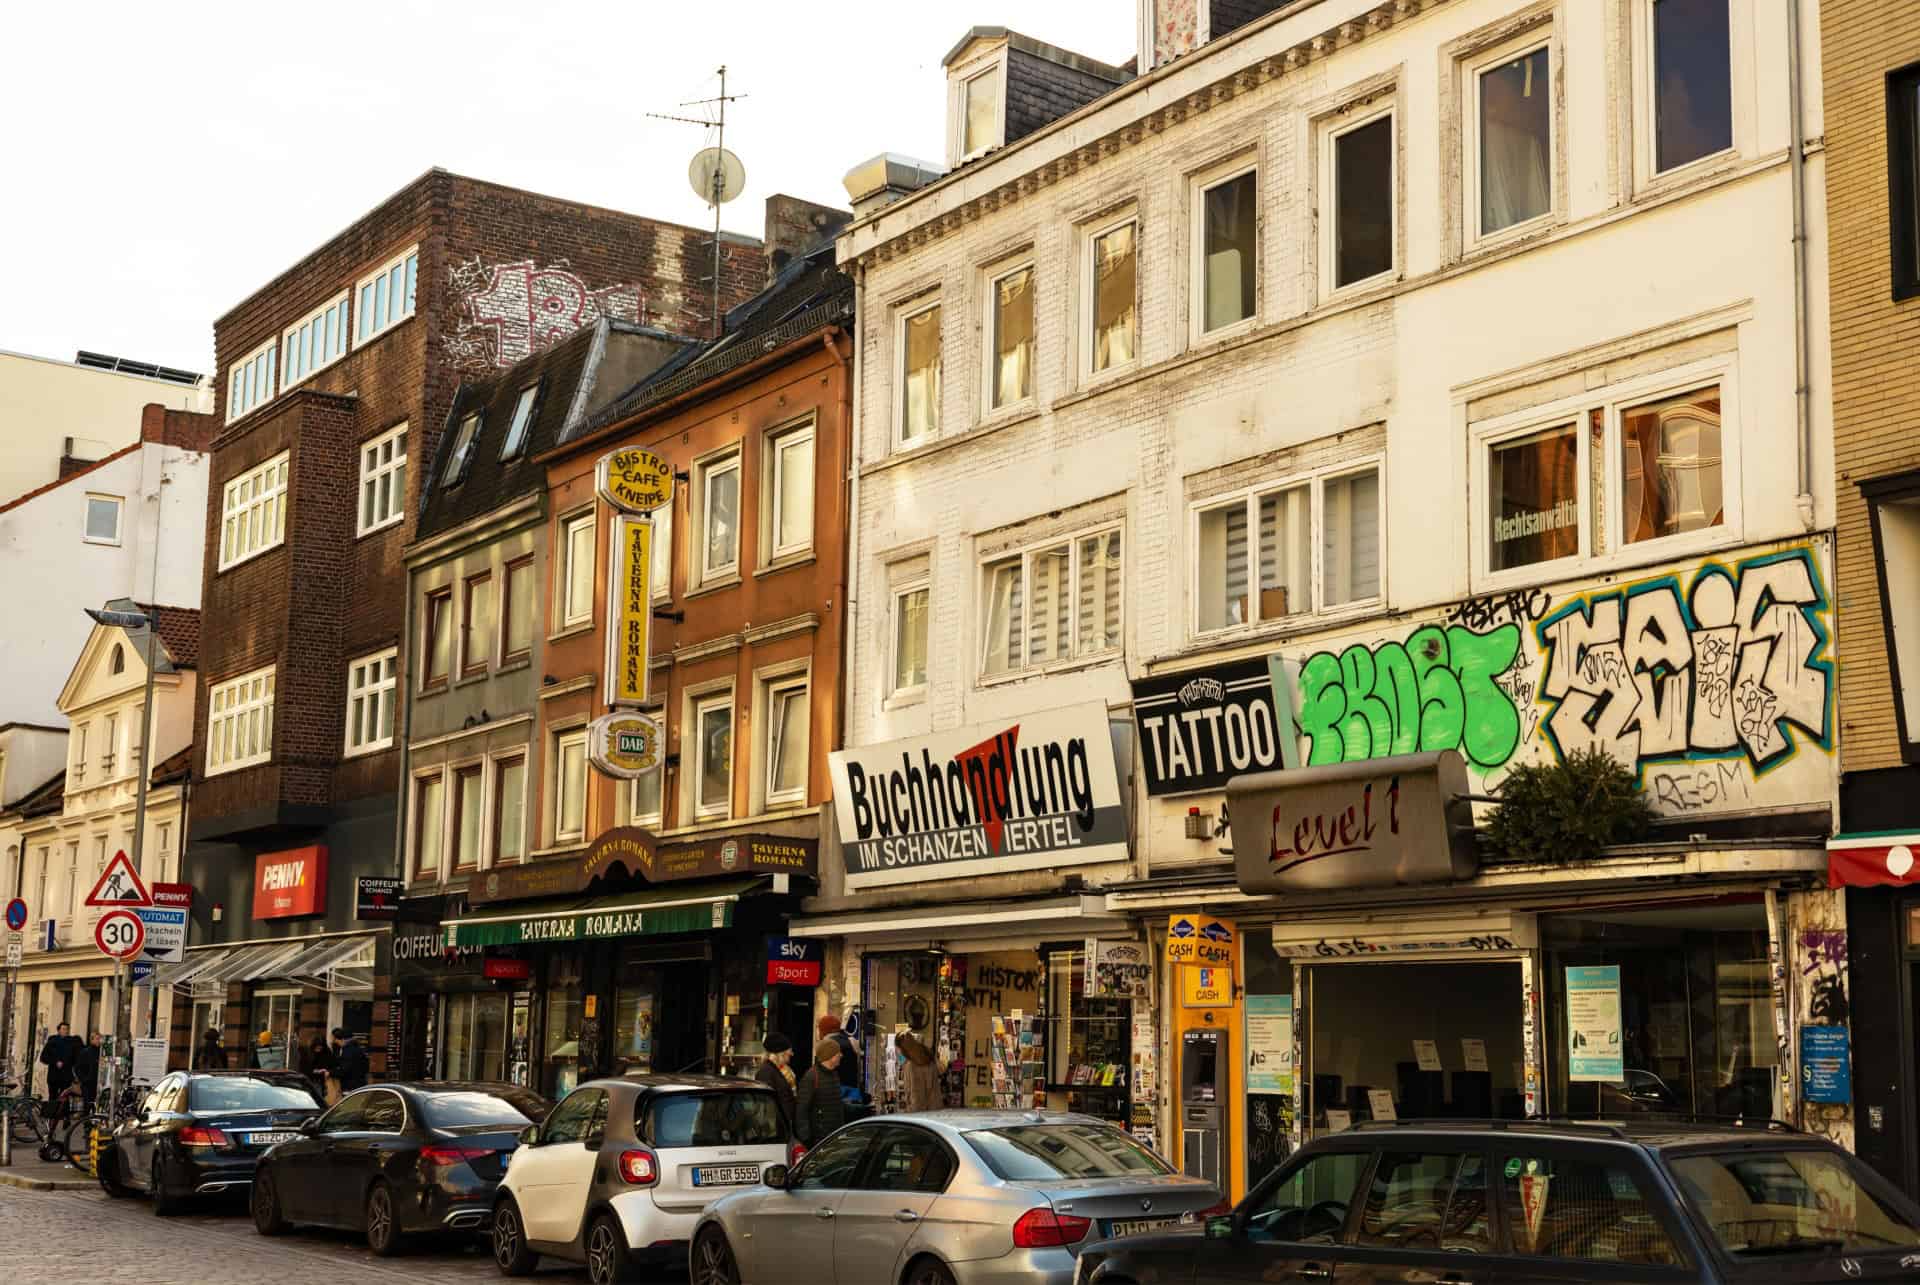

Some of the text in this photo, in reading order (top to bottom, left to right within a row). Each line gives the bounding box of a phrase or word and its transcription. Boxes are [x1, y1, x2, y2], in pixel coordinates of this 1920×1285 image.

[615, 452, 669, 475] BISTRO
[623, 470, 660, 487] CAFE
[616, 482, 665, 505] KNEIPE
[627, 529, 643, 693] TAVERNA ROMANA
[621, 736, 644, 751] DAB
[1143, 699, 1275, 781] TATTOO
[846, 732, 1095, 840] Buchhandlung
[1269, 783, 1376, 862] Level
[751, 843, 806, 857] TAVERNA
[858, 844, 880, 870] IM
[753, 854, 804, 867] ROMANA
[359, 879, 399, 888] COIFFEUR
[106, 923, 134, 944] 30
[520, 912, 643, 940] TAVERNA ROMANA
[780, 941, 807, 959] sky
[1168, 943, 1193, 956] CASH
[1198, 944, 1230, 961] CASH
[1195, 990, 1220, 1000] CASH
[700, 1167, 758, 1183] HH GR 5555
